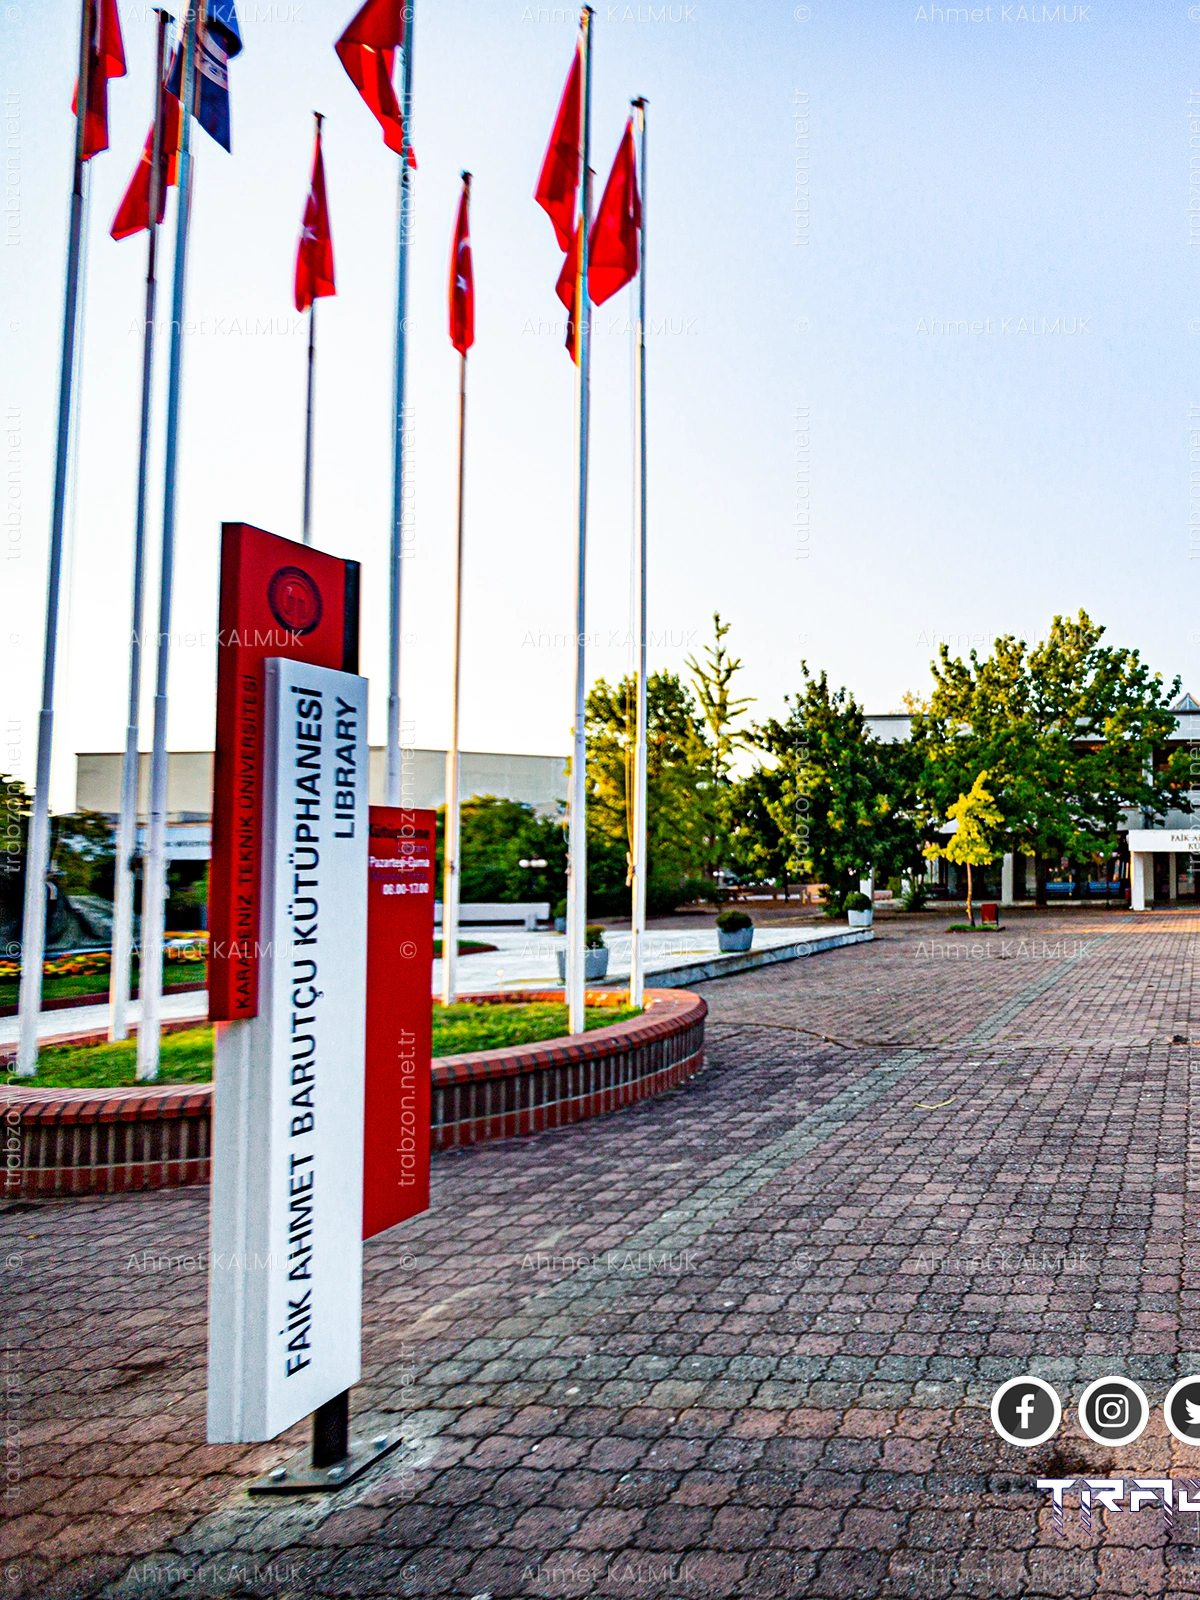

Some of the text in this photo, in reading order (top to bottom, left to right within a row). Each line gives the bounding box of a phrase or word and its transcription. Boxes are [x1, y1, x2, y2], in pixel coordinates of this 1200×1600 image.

[234, 674, 257, 1009] KARADENİZ TEKNİK ÜNİVERSİTESİ
[334, 696, 358, 838] LIBRARY
[279, 685, 324, 1379] FAİK AHMET BARUTÇU KÜTÜPHANESİ
